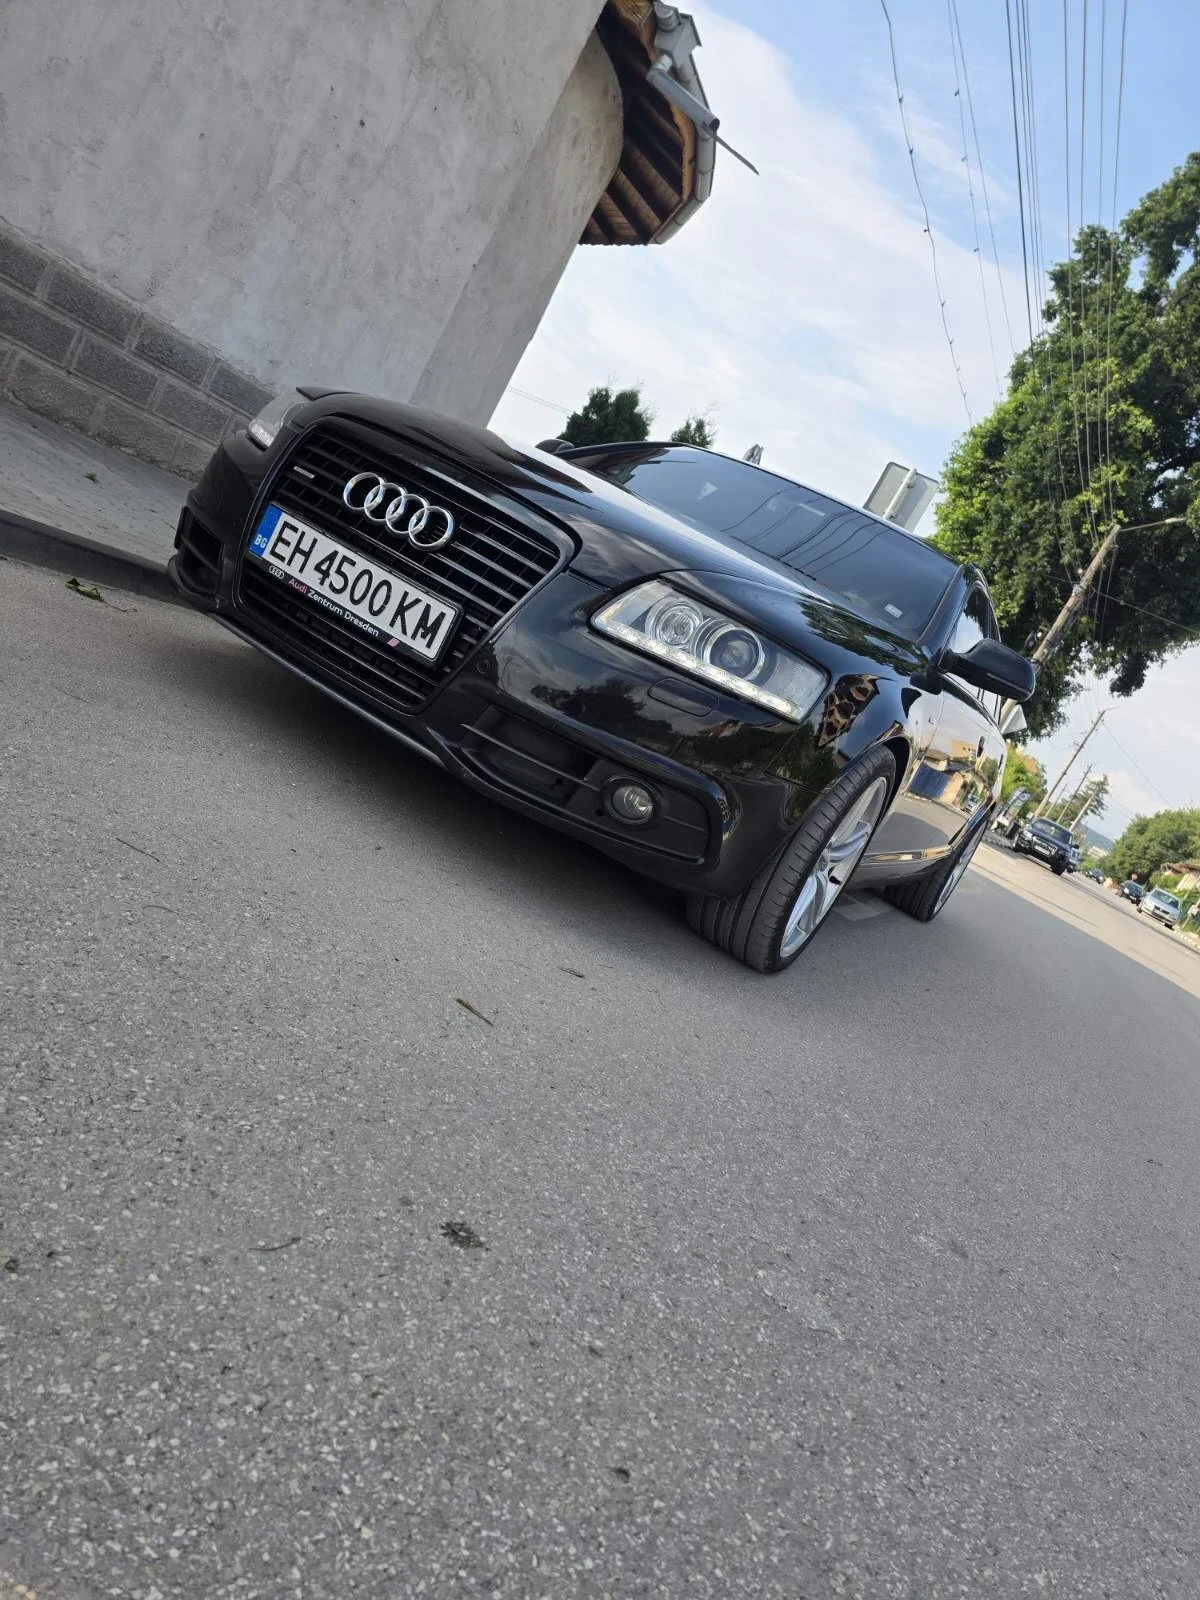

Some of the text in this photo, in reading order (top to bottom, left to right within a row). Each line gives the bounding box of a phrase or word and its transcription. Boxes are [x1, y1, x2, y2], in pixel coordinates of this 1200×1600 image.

[254, 534, 268, 549] BG
[288, 578, 379, 637] Audi Zentrum Dresden
